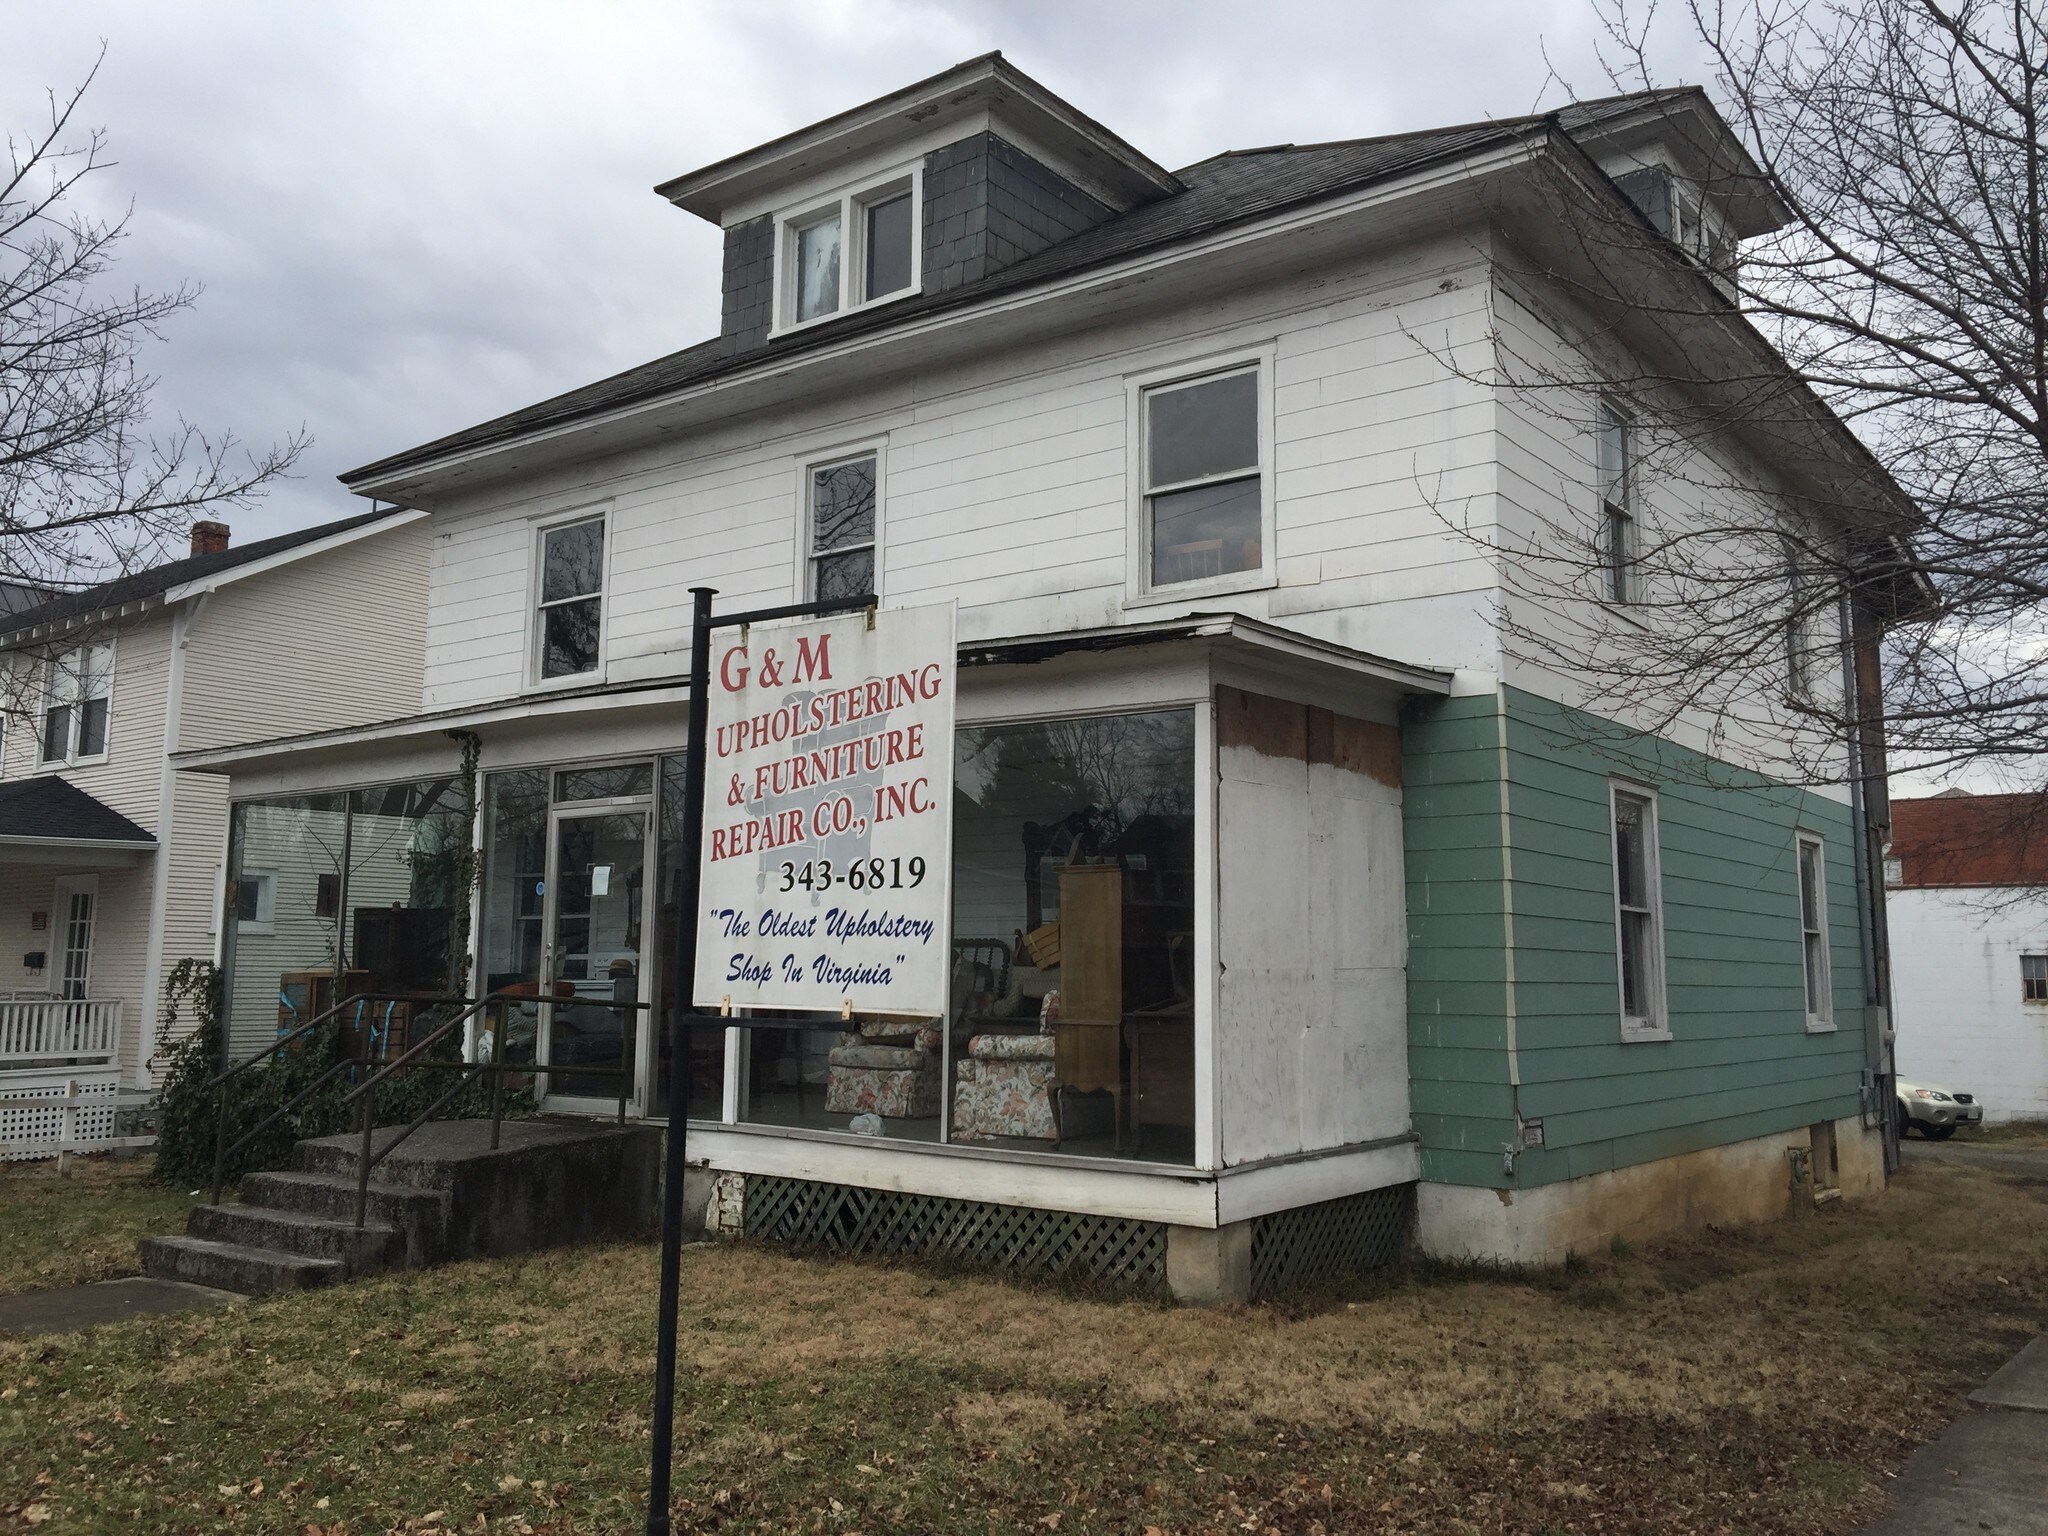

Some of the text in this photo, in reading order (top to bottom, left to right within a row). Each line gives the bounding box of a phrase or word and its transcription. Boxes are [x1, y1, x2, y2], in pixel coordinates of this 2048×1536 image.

[720, 634, 832, 692] G & M
[717, 663, 941, 758] UPHOLSTERING
[727, 724, 924, 806] & FURNITURE
[710, 777, 936, 862] REPAIR CO., INC.
[779, 856, 926, 892] 343-6819
[710, 907, 934, 946] "The Oldest Upholstery
[726, 953, 905, 994] Shop In Virginia"
